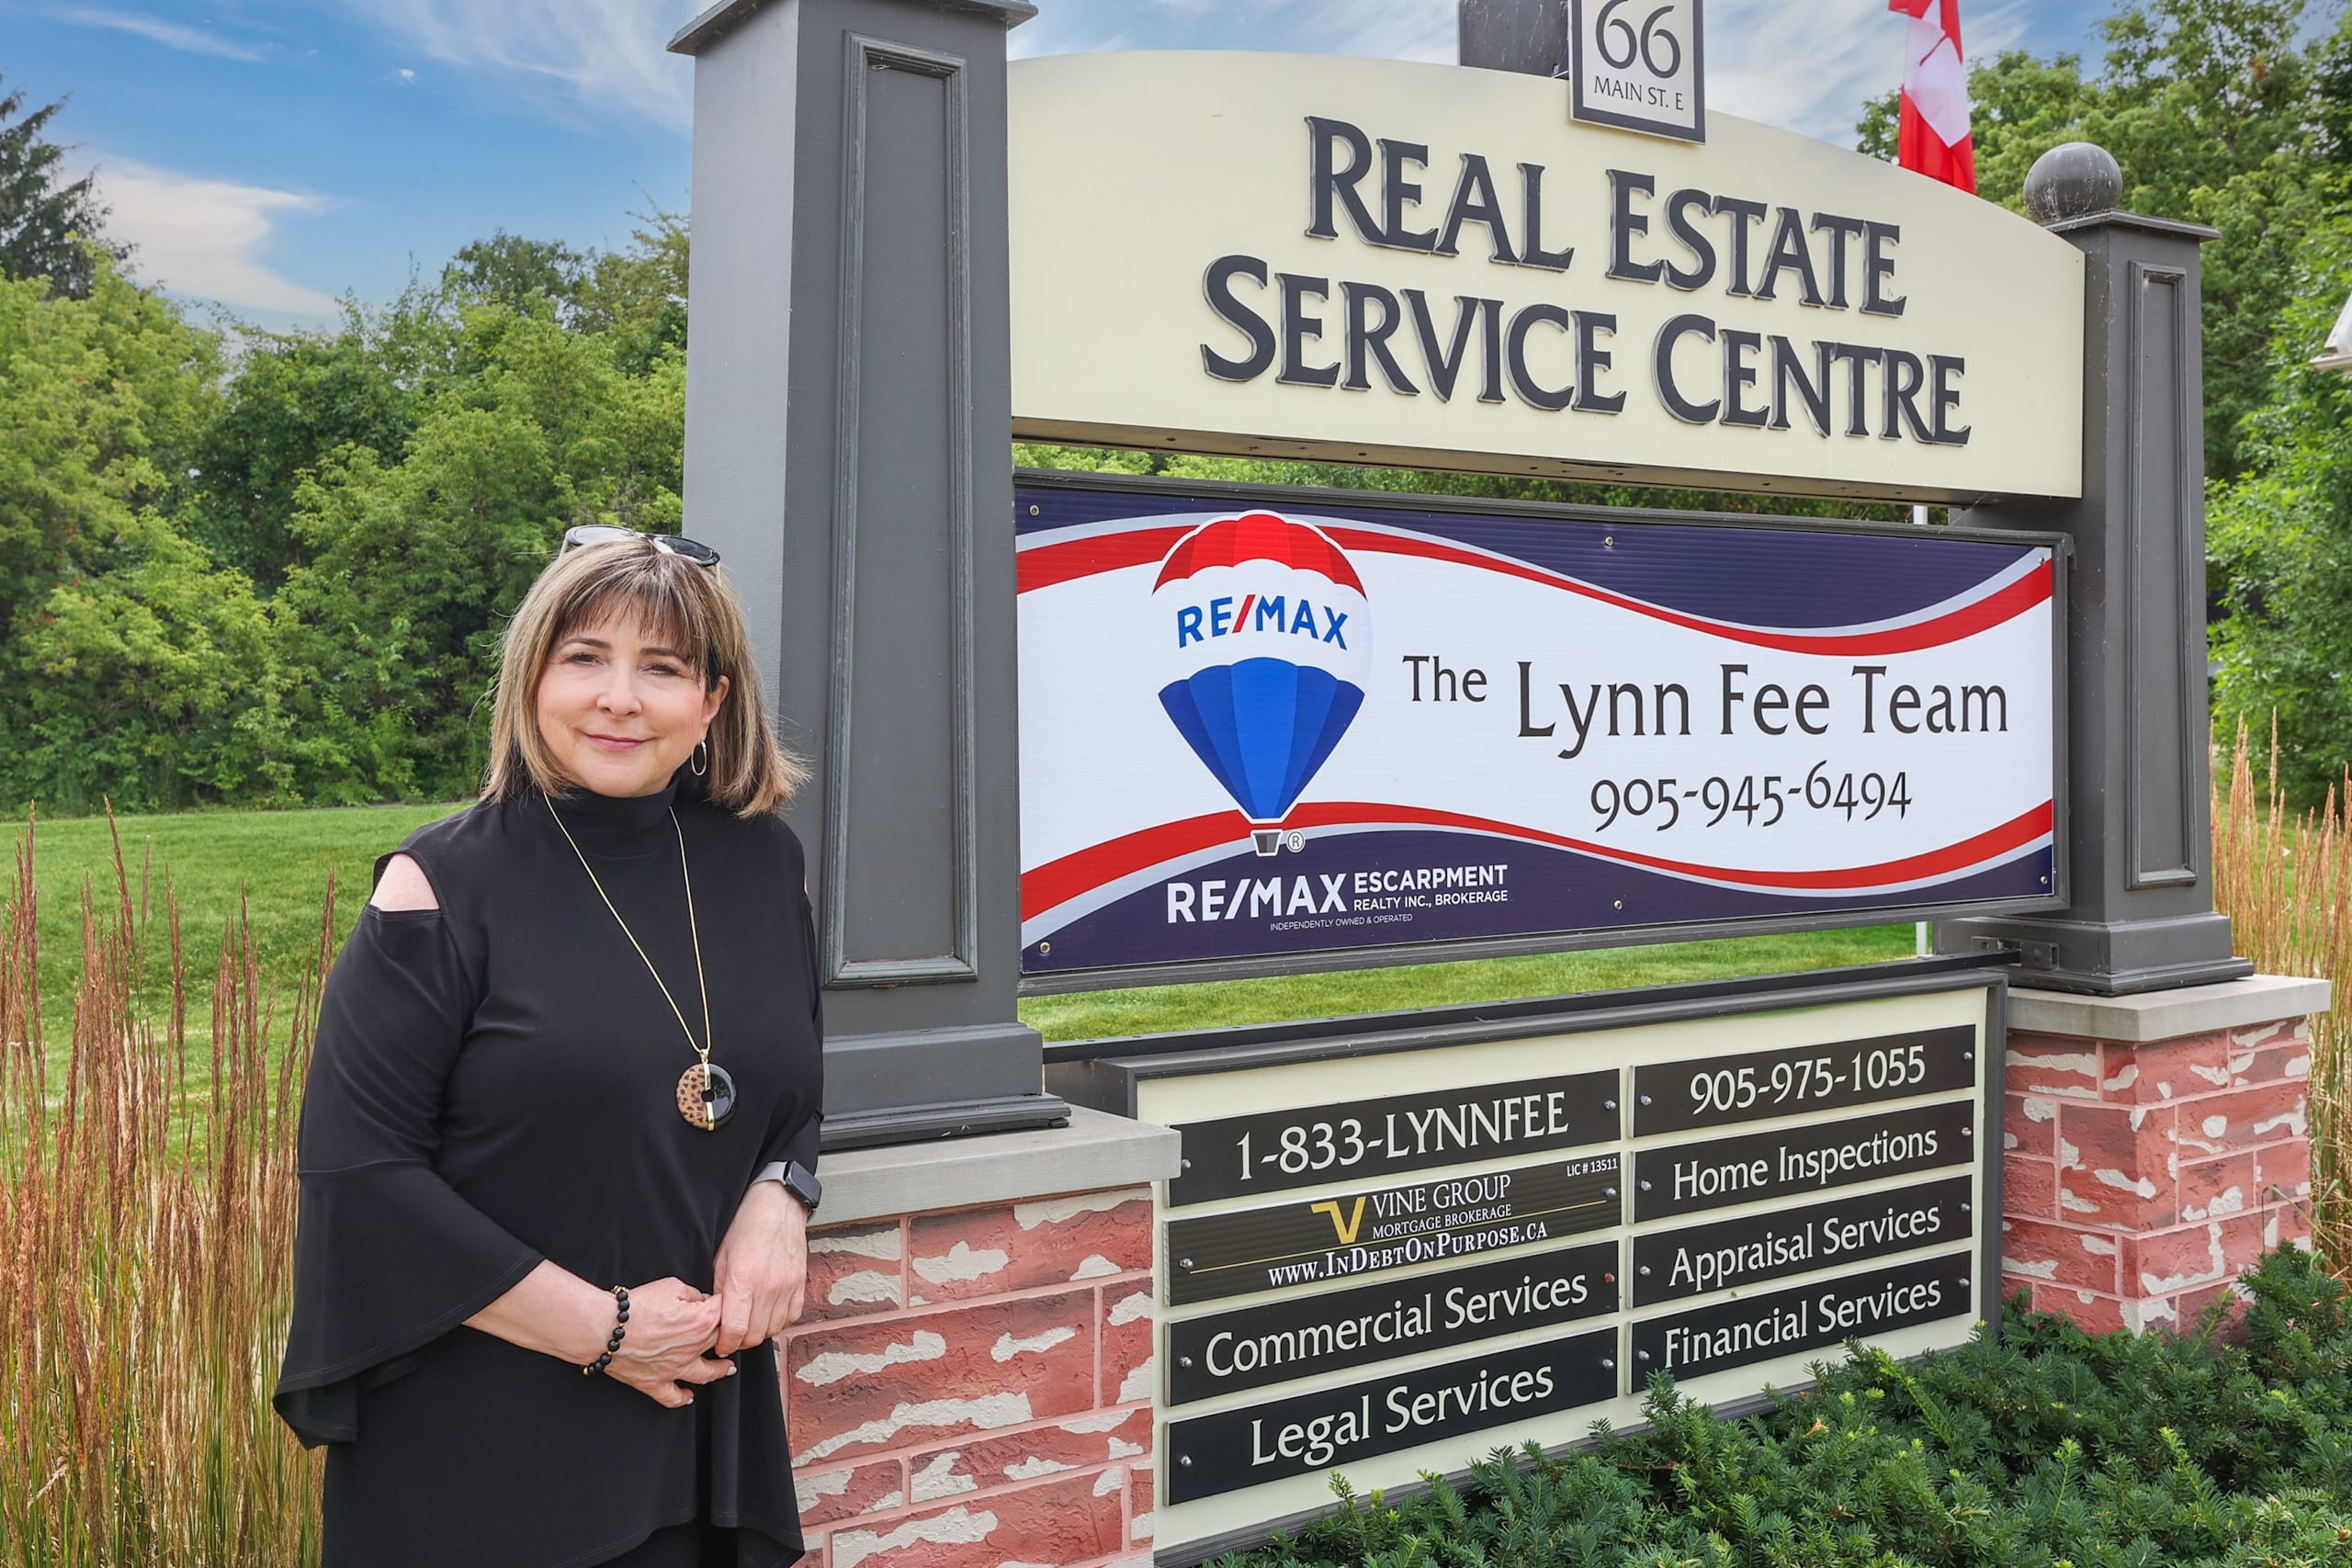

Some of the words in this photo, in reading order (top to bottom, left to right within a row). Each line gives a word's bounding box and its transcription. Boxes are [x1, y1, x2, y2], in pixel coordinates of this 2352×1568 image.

[1596, 0, 1680, 79] 66
[1594, 76, 1642, 103] MAIN
[1647, 87, 1669, 108] ST.
[1675, 92, 1684, 111] E
[1304, 115, 1574, 273] REAL
[1605, 168, 1906, 318] ESTATE
[1199, 254, 1627, 415] SERVICE
[1651, 312, 1972, 447] CENTRE
[1177, 594, 1348, 650] RE/MAX
[1403, 655, 1487, 702] The
[1517, 660, 1690, 760] Lynn
[1720, 663, 1830, 736] Fee
[1851, 665, 2008, 733] Team
[1590, 760, 1913, 832] 905-945-6494
[1166, 873, 1348, 924] RE/MAX
[1353, 864, 1509, 894] ESCARPMENT
[1270, 919, 1335, 932] INDEPENDENTLY
[1335, 916, 1365, 927] OWNED
[1366, 916, 1373, 924] &
[1374, 913, 1413, 924] OPERATED
[1353, 896, 1401, 912] REALTY
[1404, 894, 1432, 910] INC.,
[1435, 890, 1509, 907] BROKERAGE
[1690, 1044, 1927, 1115] 905-975-1055
[1237, 1090, 1569, 1181] 1-833-LYNNFEE
[1566, 1163, 1581, 1178] LIC
[1590, 1157, 1618, 1173] 13511
[1673, 1157, 1769, 1201] Home
[1779, 1128, 1939, 1185] Inspections
[1372, 1189, 1427, 1219] VINE
[1433, 1174, 1511, 1210] GROUP
[1372, 1216, 1442, 1240] MORTGAGE
[1444, 1203, 1512, 1229] BROKERAGE
[1668, 1223, 1814, 1292] Appraisal
[1823, 1205, 1941, 1256] Services
[1205, 1293, 1432, 1378] Commercial
[1444, 1272, 1589, 1330] Services
[1665, 1300, 1808, 1370] Financial
[1817, 1279, 1942, 1335] Services
[1250, 1394, 1370, 1467] Legal
[1385, 1365, 1555, 1434] Services
